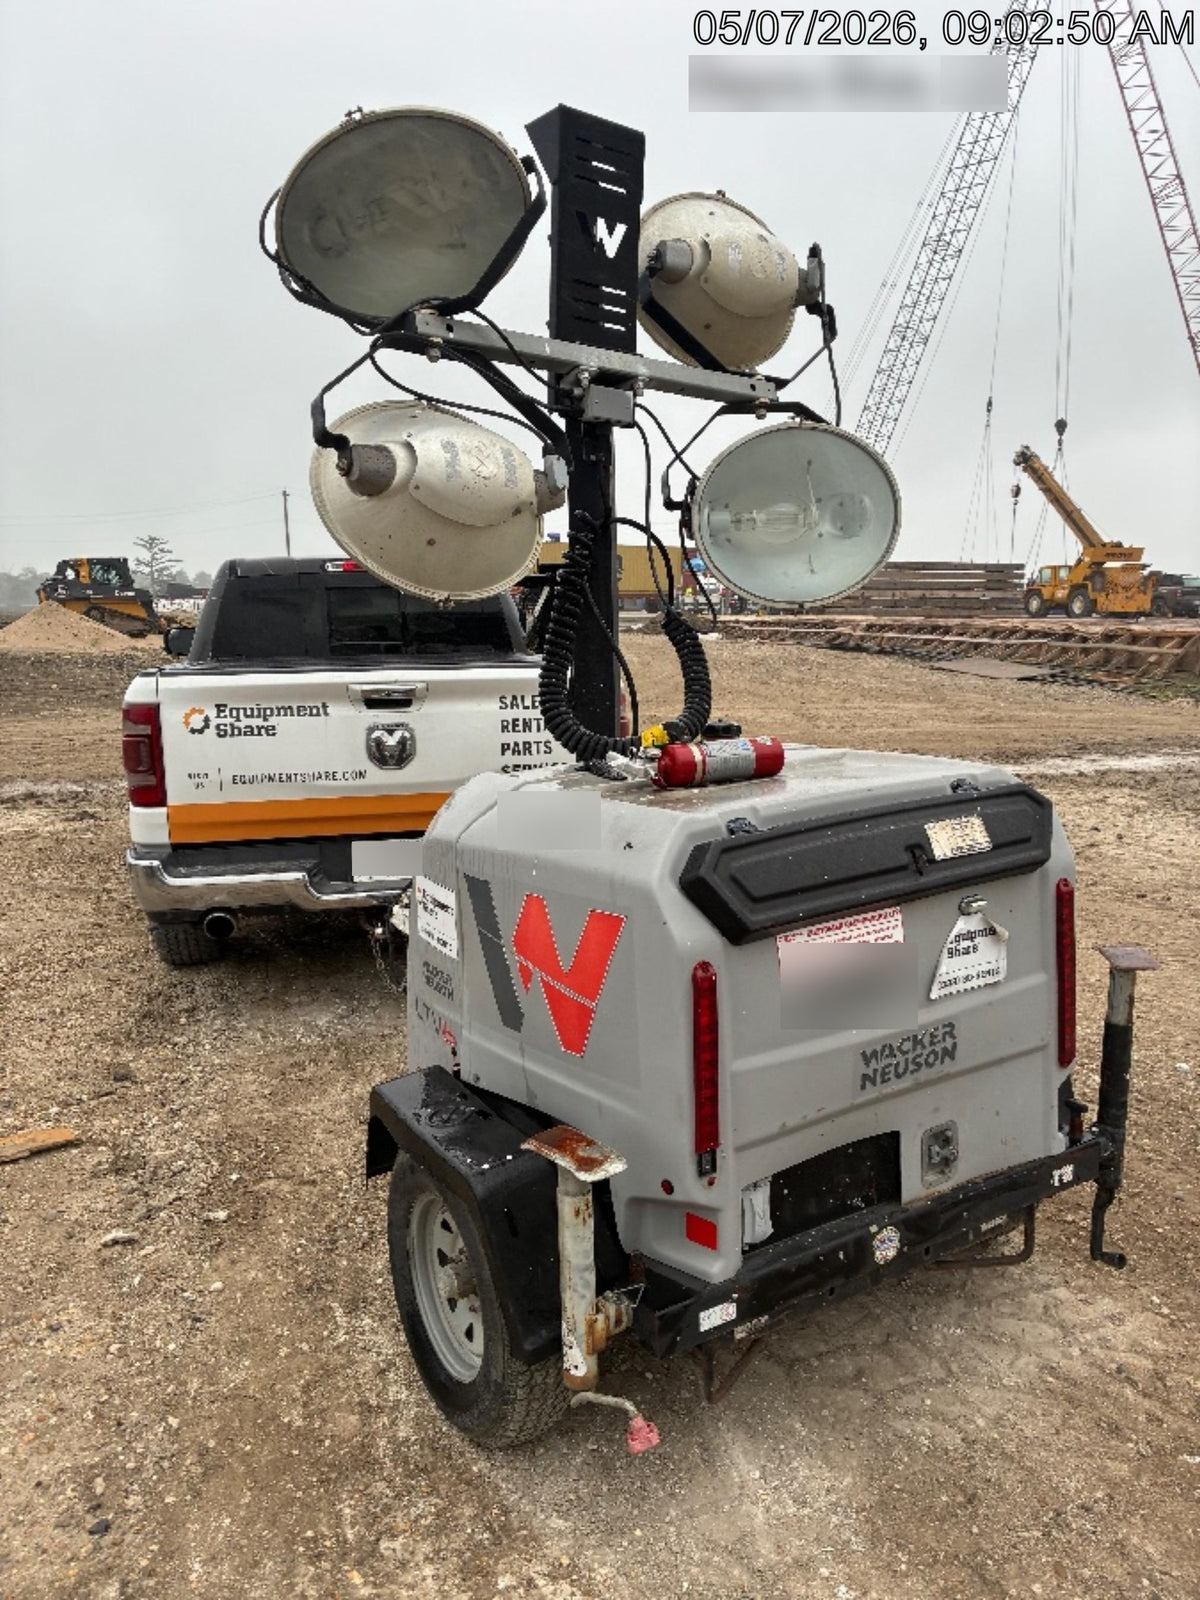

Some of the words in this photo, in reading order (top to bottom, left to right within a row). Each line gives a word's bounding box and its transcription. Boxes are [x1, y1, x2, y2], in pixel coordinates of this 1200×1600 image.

[499, 695, 541, 710] SALE
[214, 702, 330, 722] Equipment
[214, 722, 278, 738] Share
[500, 717, 545, 733] RENT
[500, 740, 553, 756] PARTS
[231, 769, 368, 785] EQUIPMENTSHARE.COM
[860, 1021, 957, 1068] WACKER
[860, 1041, 957, 1091] NEUSON
